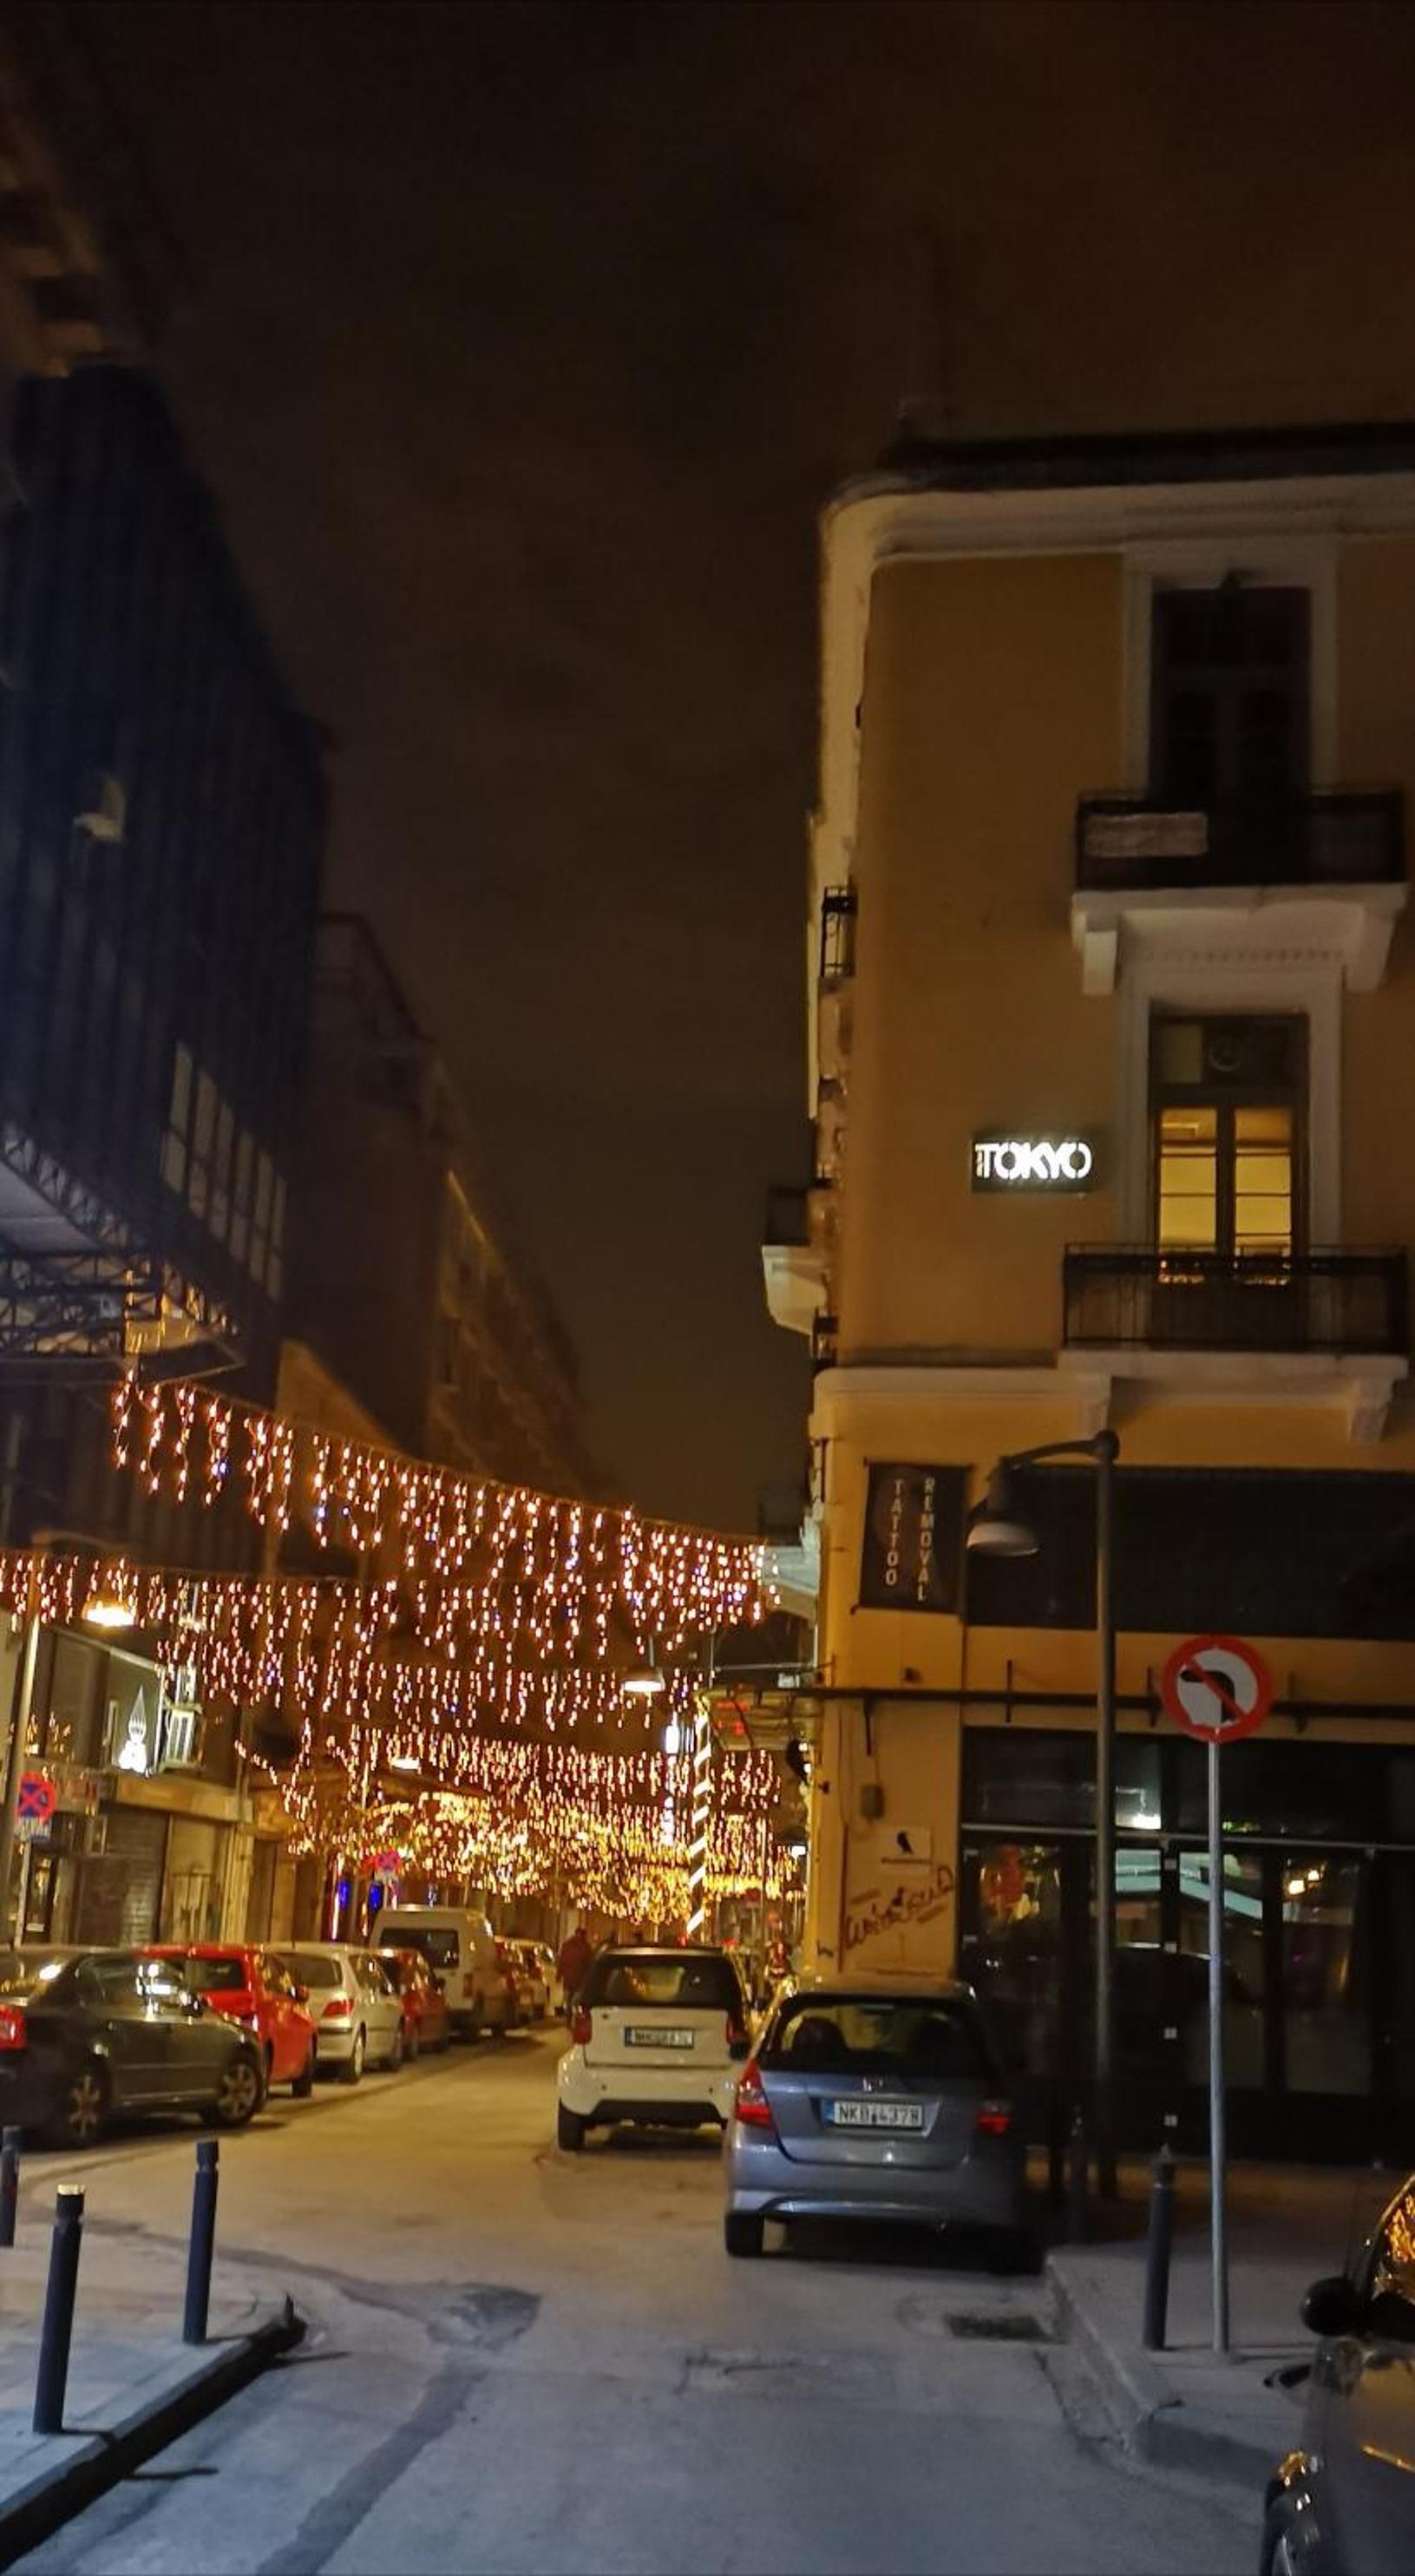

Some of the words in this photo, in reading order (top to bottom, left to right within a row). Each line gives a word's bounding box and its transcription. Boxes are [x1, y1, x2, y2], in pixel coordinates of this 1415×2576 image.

[975, 1142, 1091, 1179] TOKYO
[885, 1478, 903, 1586] TATTOO
[917, 1478, 935, 1602] REMOVAL
